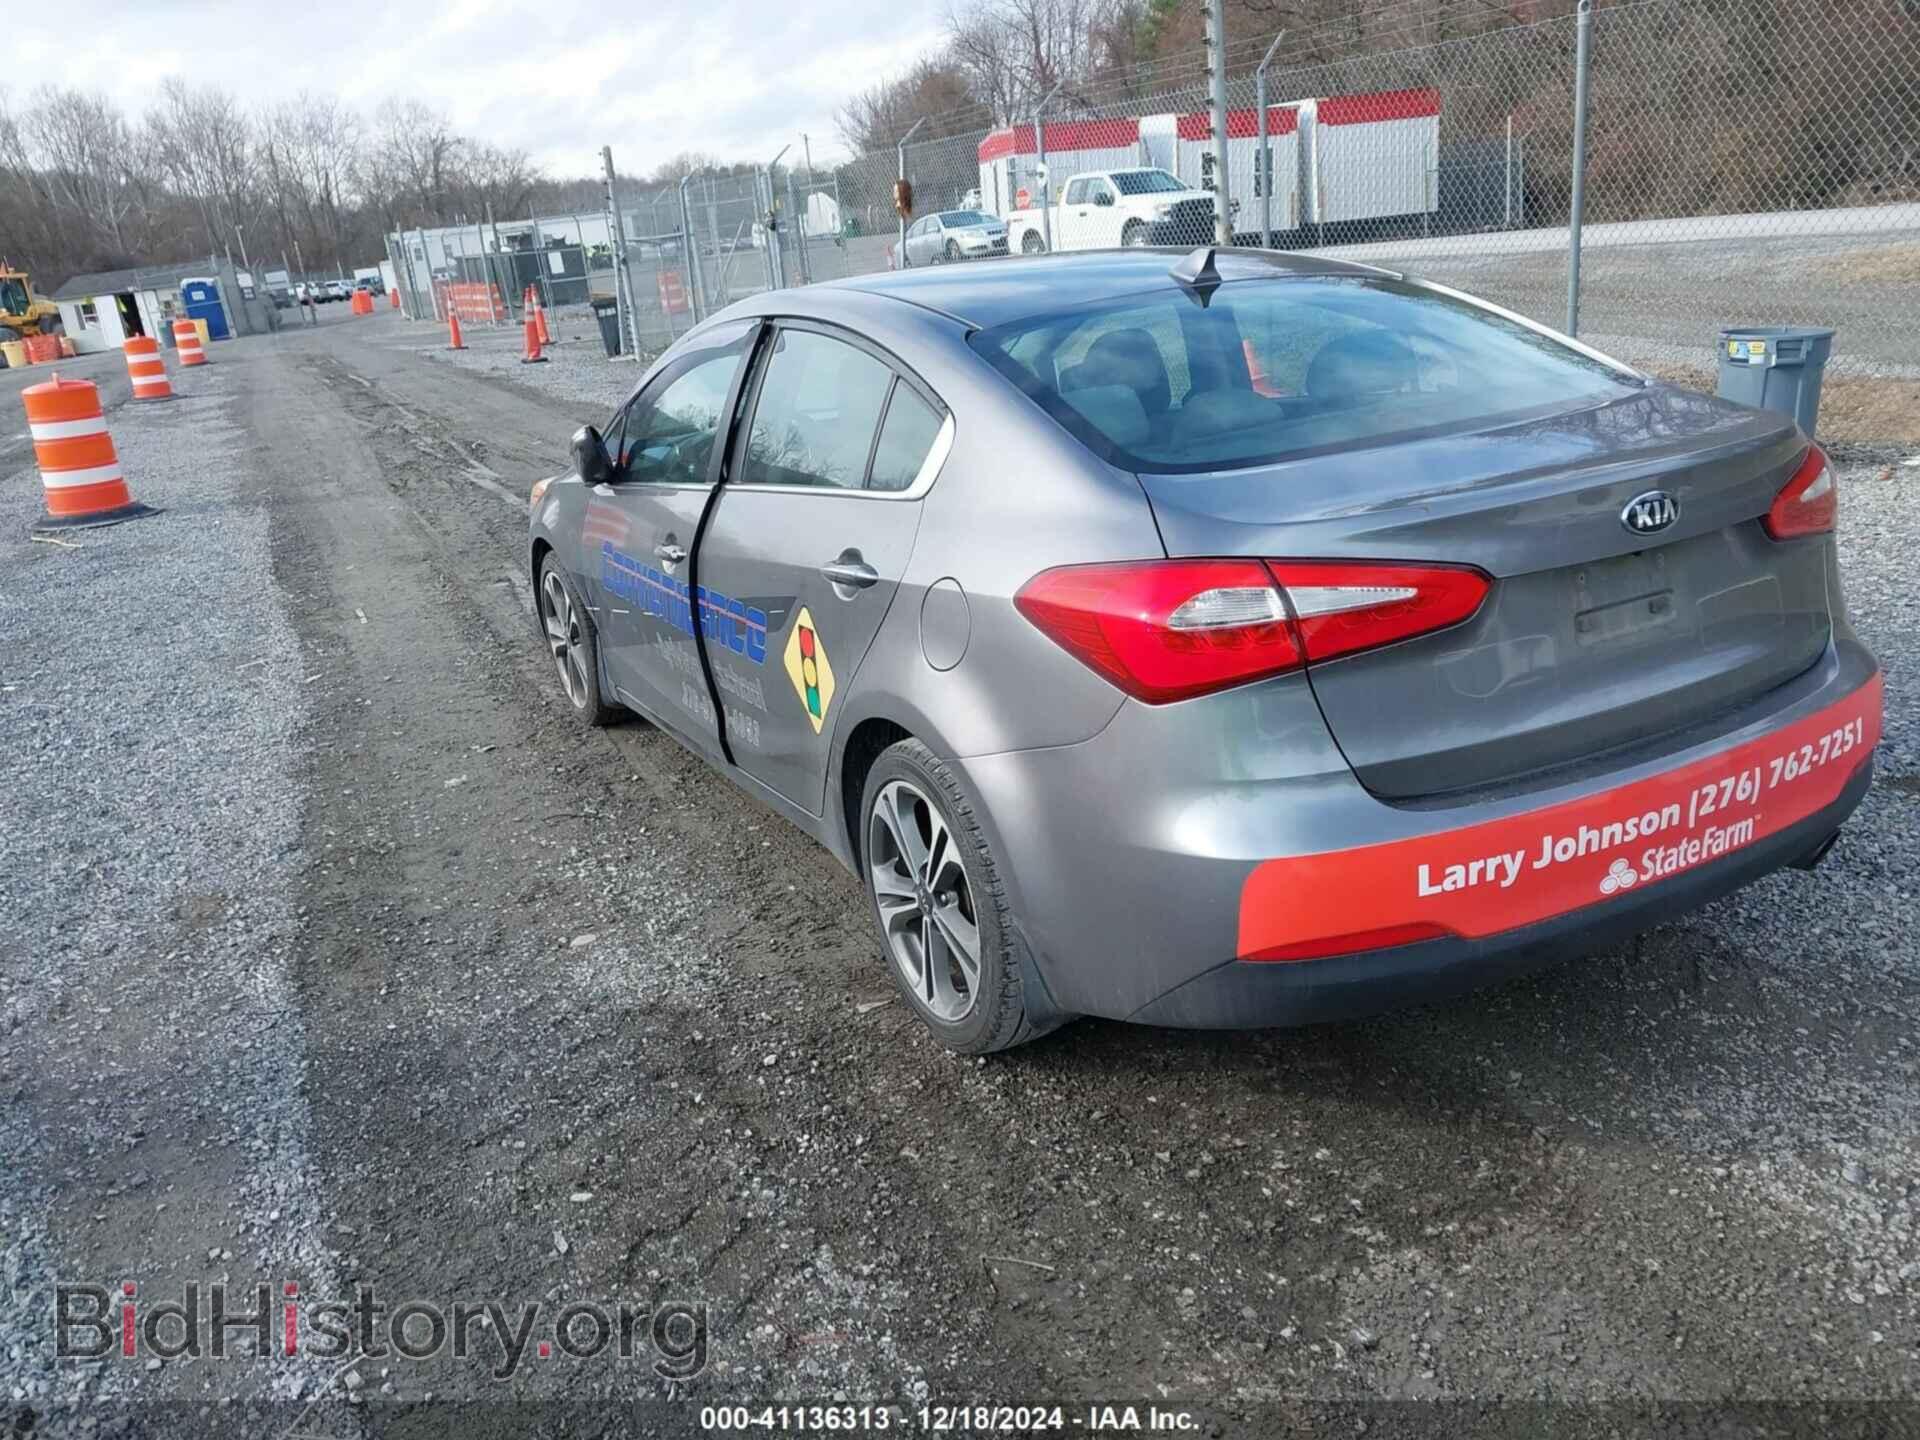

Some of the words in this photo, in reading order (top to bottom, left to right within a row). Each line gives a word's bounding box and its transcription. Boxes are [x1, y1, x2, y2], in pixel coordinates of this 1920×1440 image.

[1634, 497, 1677, 529] KIA
[1418, 850, 1525, 897] Larry
[1532, 802, 1681, 869] Johnson
[1687, 766, 1761, 829] (276)
[1768, 716, 1863, 789] 762-7251
